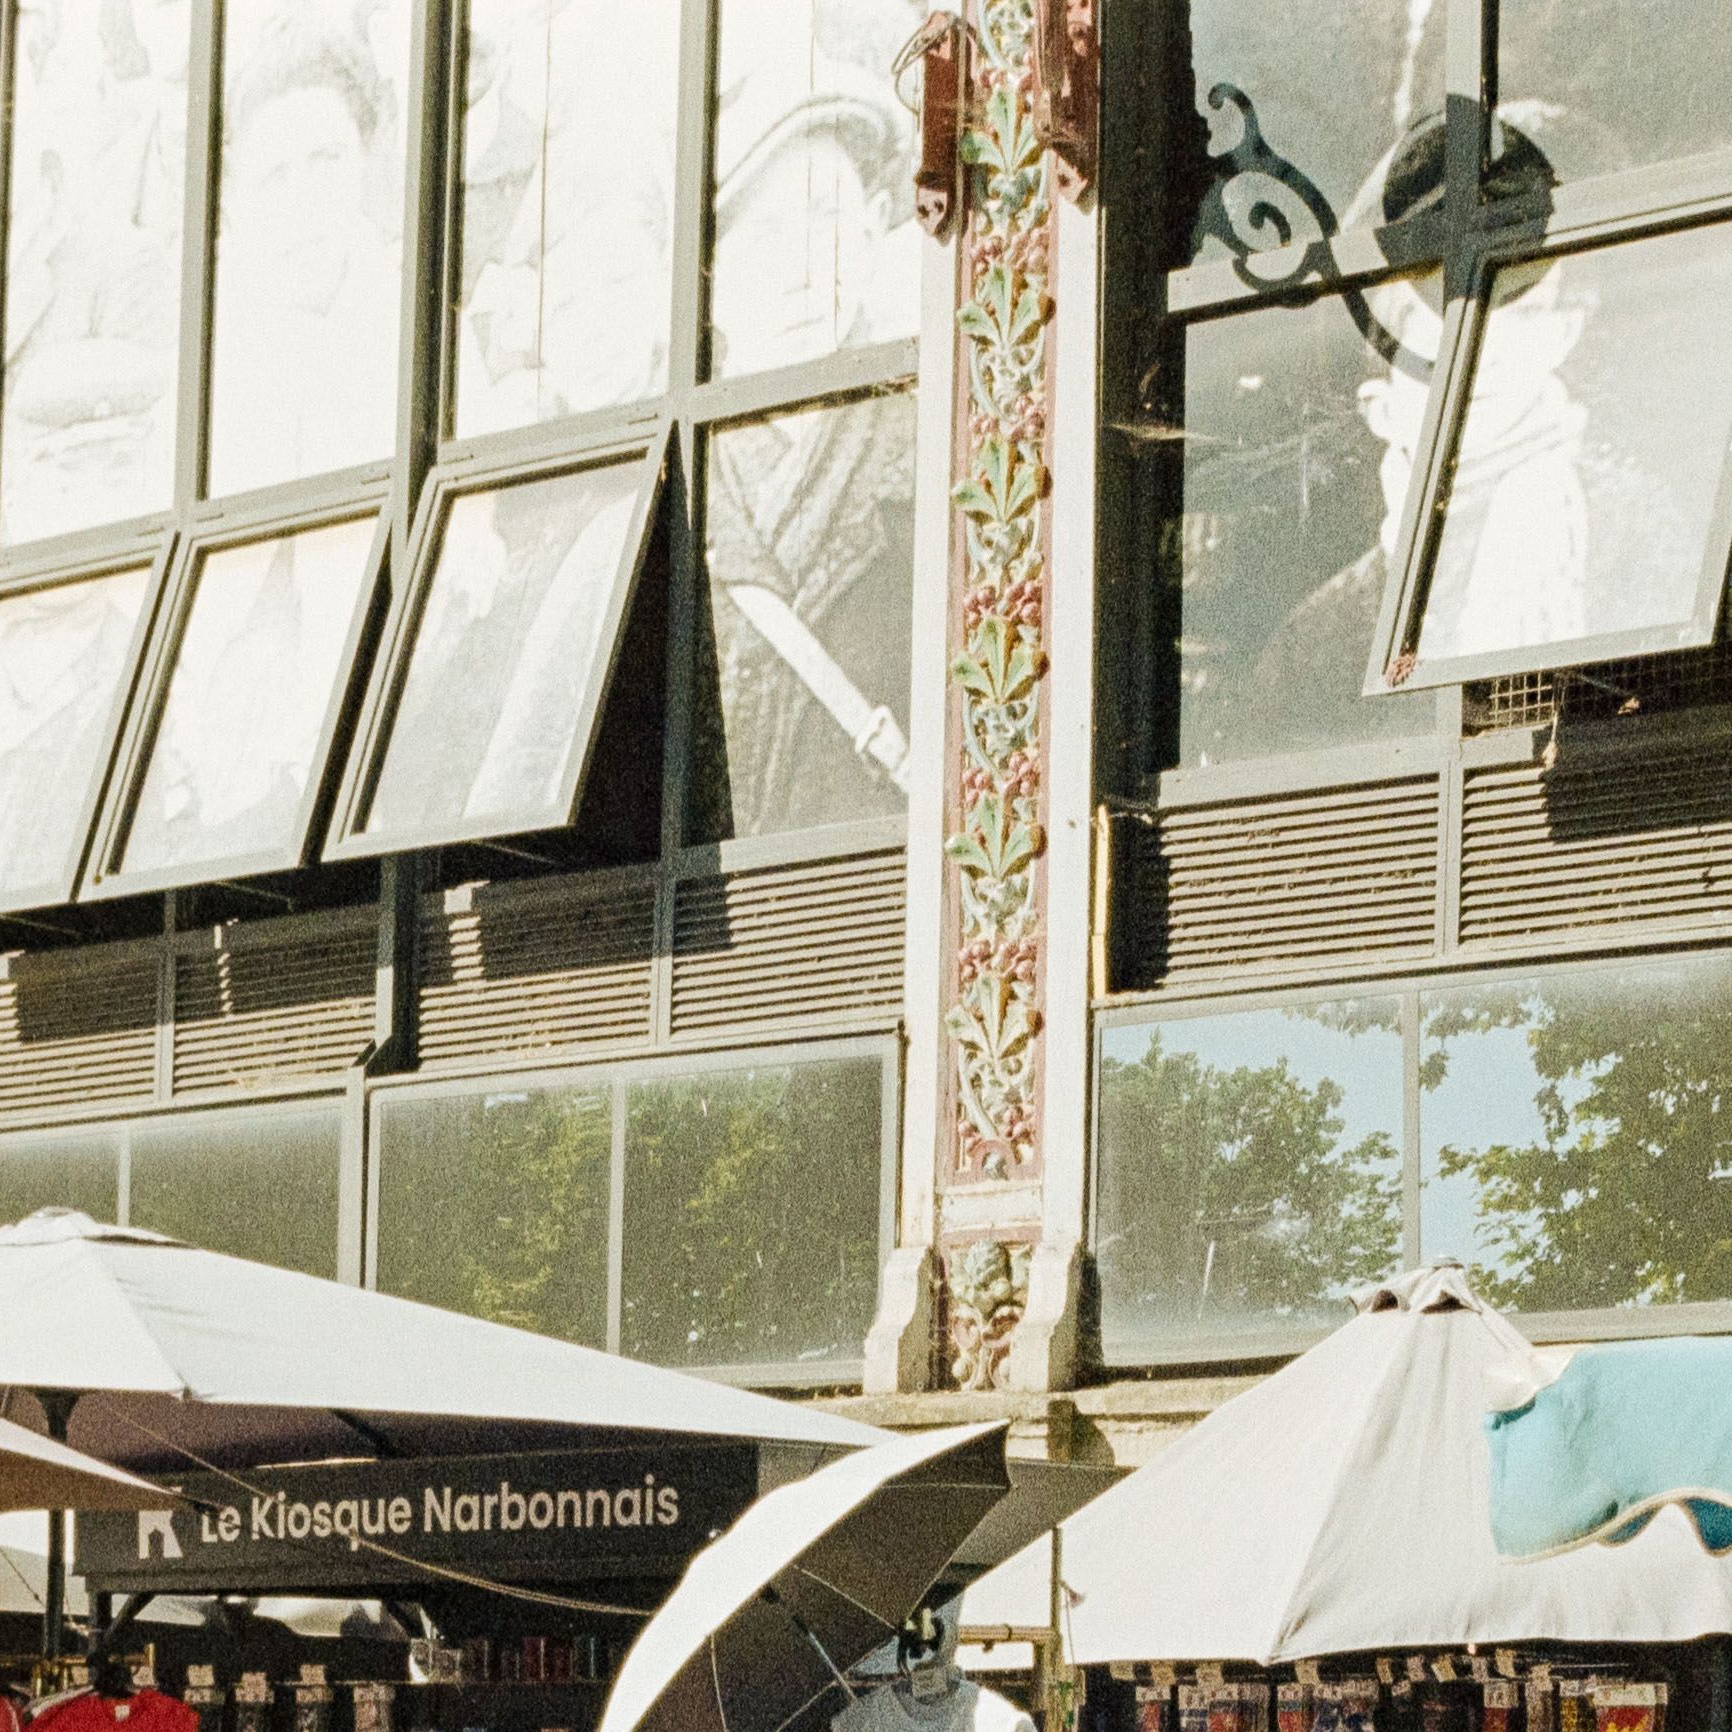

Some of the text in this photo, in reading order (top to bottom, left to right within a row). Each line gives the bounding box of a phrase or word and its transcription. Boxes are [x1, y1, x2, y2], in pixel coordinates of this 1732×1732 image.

[201, 1505, 242, 1543] Le
[251, 1489, 412, 1551] Kiosque
[423, 1473, 680, 1533] Narbonnais
